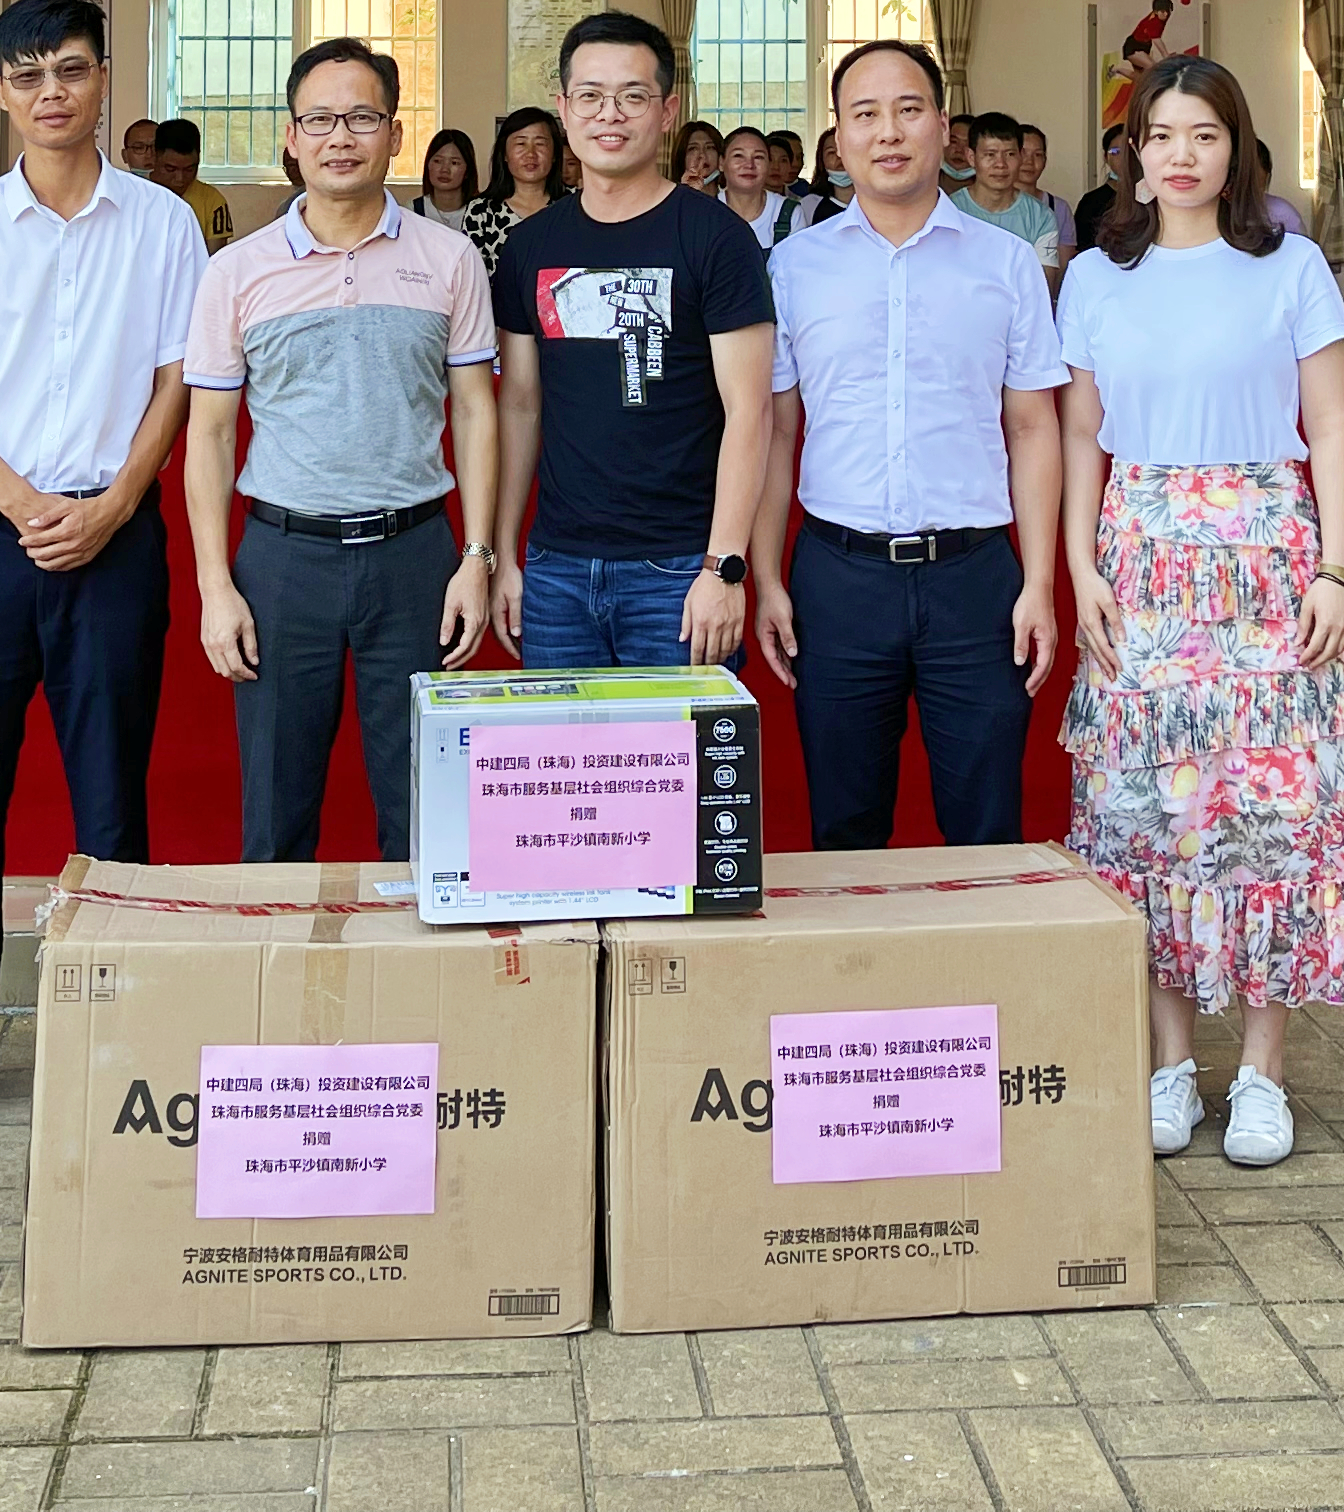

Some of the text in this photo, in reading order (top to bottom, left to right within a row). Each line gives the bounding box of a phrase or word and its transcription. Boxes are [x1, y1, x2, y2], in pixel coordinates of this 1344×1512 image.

[627, 279, 654, 294] 30TH
[618, 311, 645, 327] 20TH
[623, 333, 643, 404] SUPERMARKET
[482, 778, 685, 797] 珠海市服务基层社会组织综合党委
[570, 806, 597, 821] 捐赠
[515, 831, 651, 848] 珠海市平沙镇南新小学
[784, 1062, 987, 1086] 珠海市服务基层社会组织综合党委
[210, 1102, 424, 1120] 珠海市服务基层社会组织综合党委
[872, 1094, 900, 1110] 捐赠
[818, 1117, 954, 1139] 珠海市平沙镇南新小学
[302, 1130, 331, 1147] 捐赠
[244, 1156, 387, 1174] 珠海市平沙镇南新小学
[763, 1219, 980, 1247] 宁波安格耐特体育用品有限公司
[182, 1243, 409, 1265] 宁波安格耐特体育用品有限公司
[764, 1248, 828, 1266] AGNITE
[832, 1245, 901, 1262] SPORTS
[944, 1241, 980, 1257] LTD.
[182, 1266, 249, 1285] AGNITE
[253, 1266, 325, 1284] SPORTS
[370, 1264, 407, 1283] LTD.
